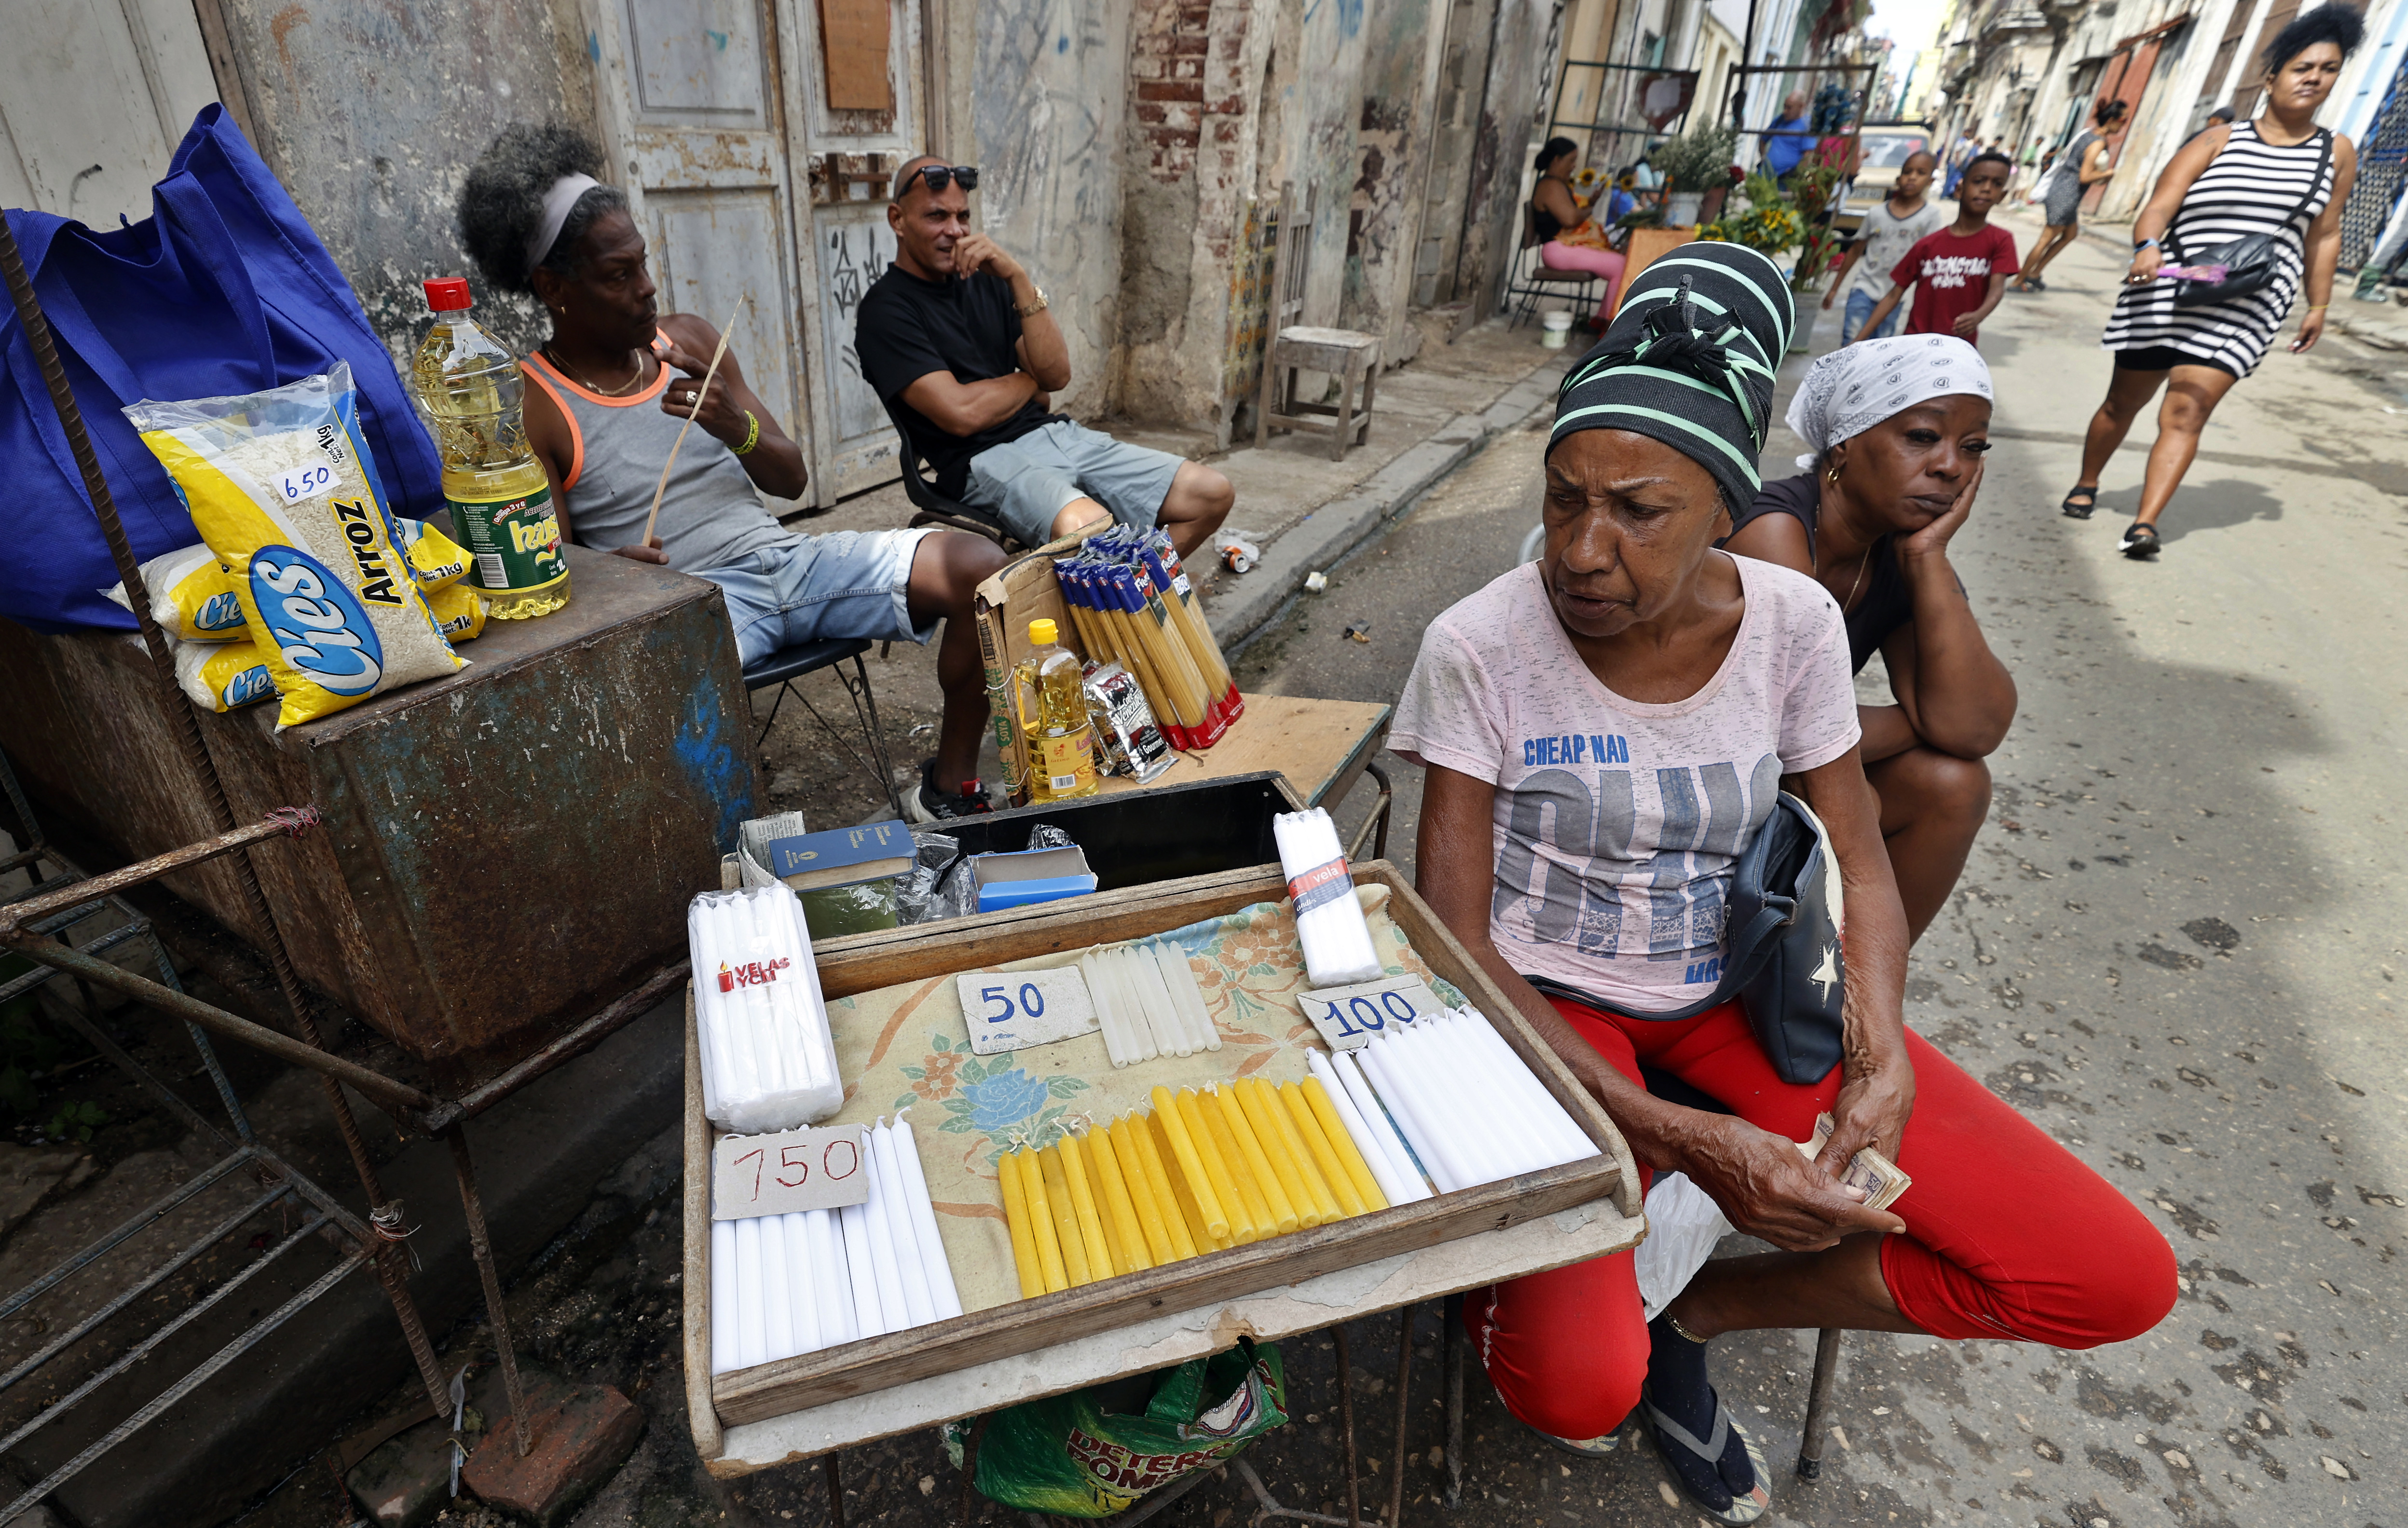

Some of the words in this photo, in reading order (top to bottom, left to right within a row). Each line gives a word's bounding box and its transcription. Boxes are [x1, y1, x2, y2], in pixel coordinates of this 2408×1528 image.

[316, 424, 335, 450] 1kg
[328, 447, 340, 464] Cont.
[334, 443, 345, 459] Net.
[285, 467, 329, 498] 650
[493, 507, 511, 524] Omega
[333, 501, 403, 605] Arroz
[424, 574, 438, 583] Net.
[435, 562, 463, 579] 1kg
[197, 594, 243, 629] Cíe
[453, 615, 471, 631] 1k
[999, 721, 1010, 742] SOYA
[1142, 737, 1164, 754] Gourmet
[1523, 735, 1586, 766] CHEAP
[1590, 735, 1630, 764] NAD
[1313, 867, 1340, 883] vela
[735, 957, 790, 977] VELAS
[737, 969, 777, 987] YCM
[982, 982, 1044, 1023] 50
[1324, 992, 1417, 1037] 100
[1868, 1176, 1882, 1191] 50
